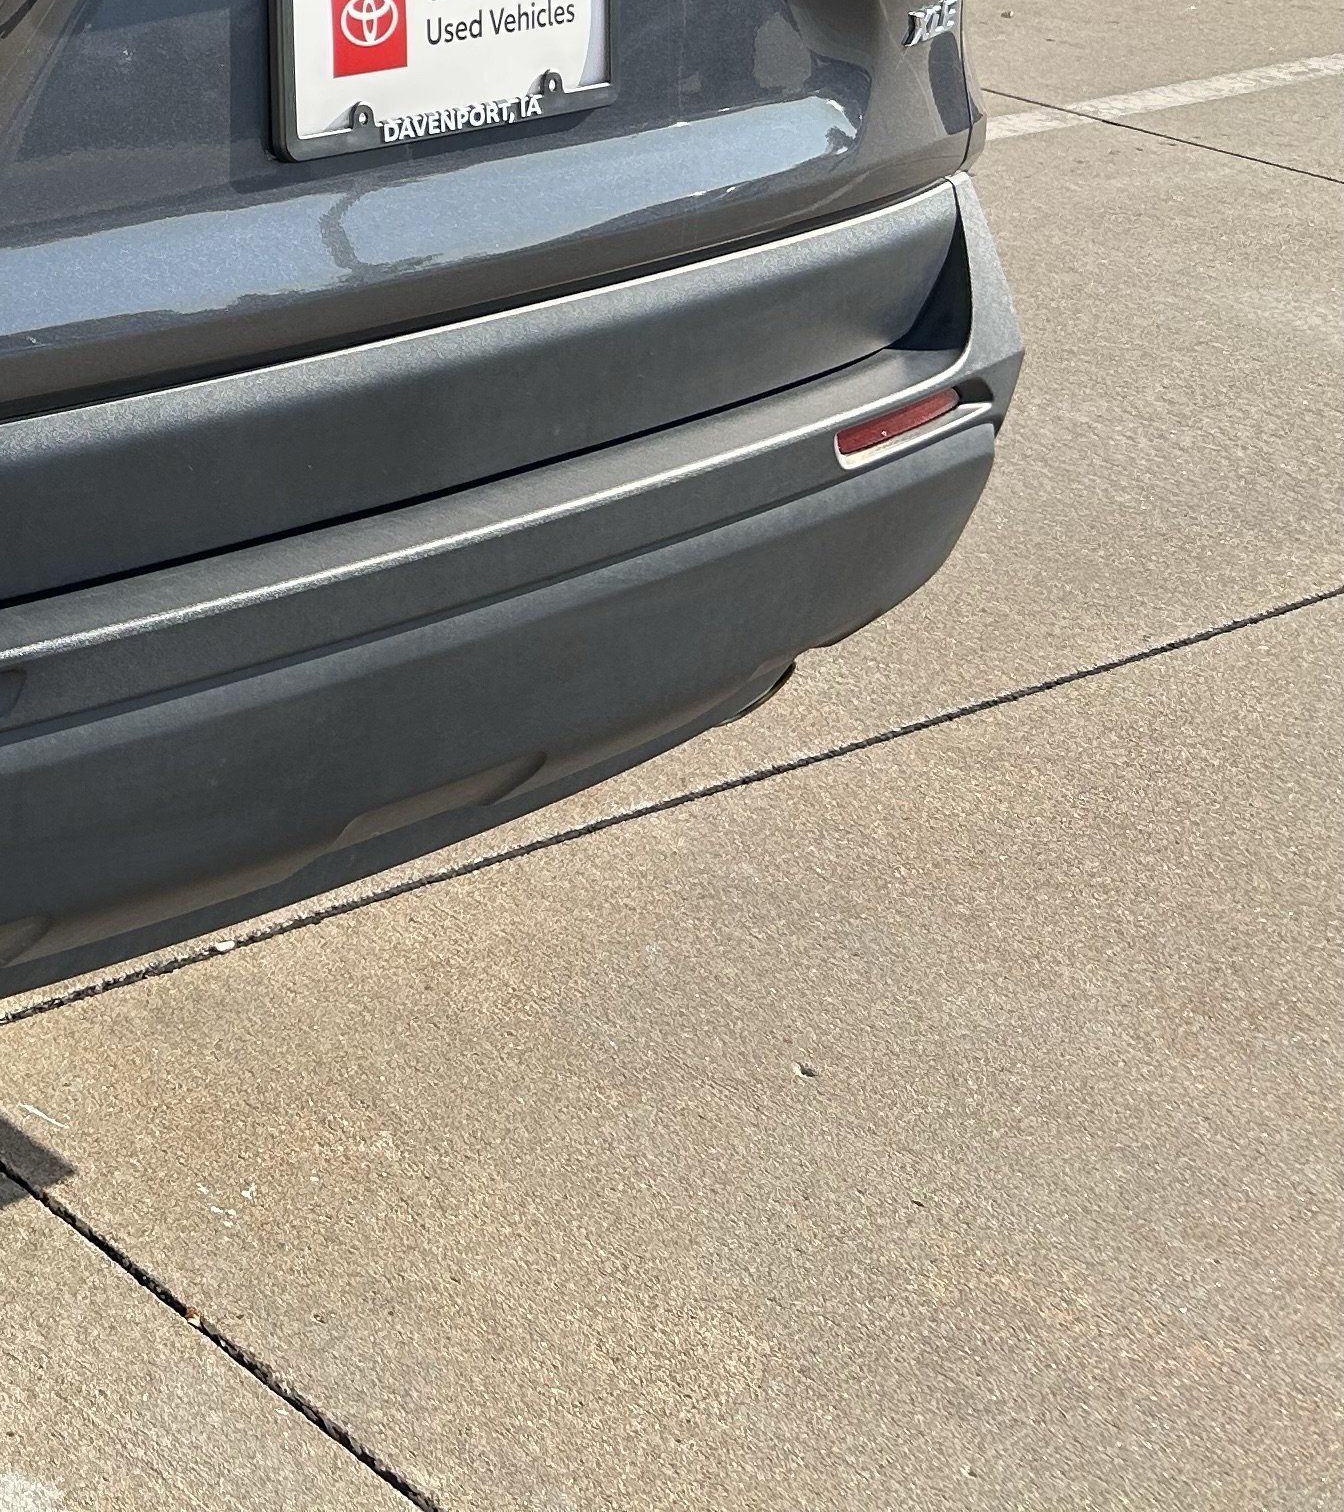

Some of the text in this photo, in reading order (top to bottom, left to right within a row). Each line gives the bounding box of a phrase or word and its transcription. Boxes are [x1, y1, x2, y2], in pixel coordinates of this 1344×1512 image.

[426, 10, 483, 46] Used
[382, 96, 542, 143] DAVENPORT, IA
